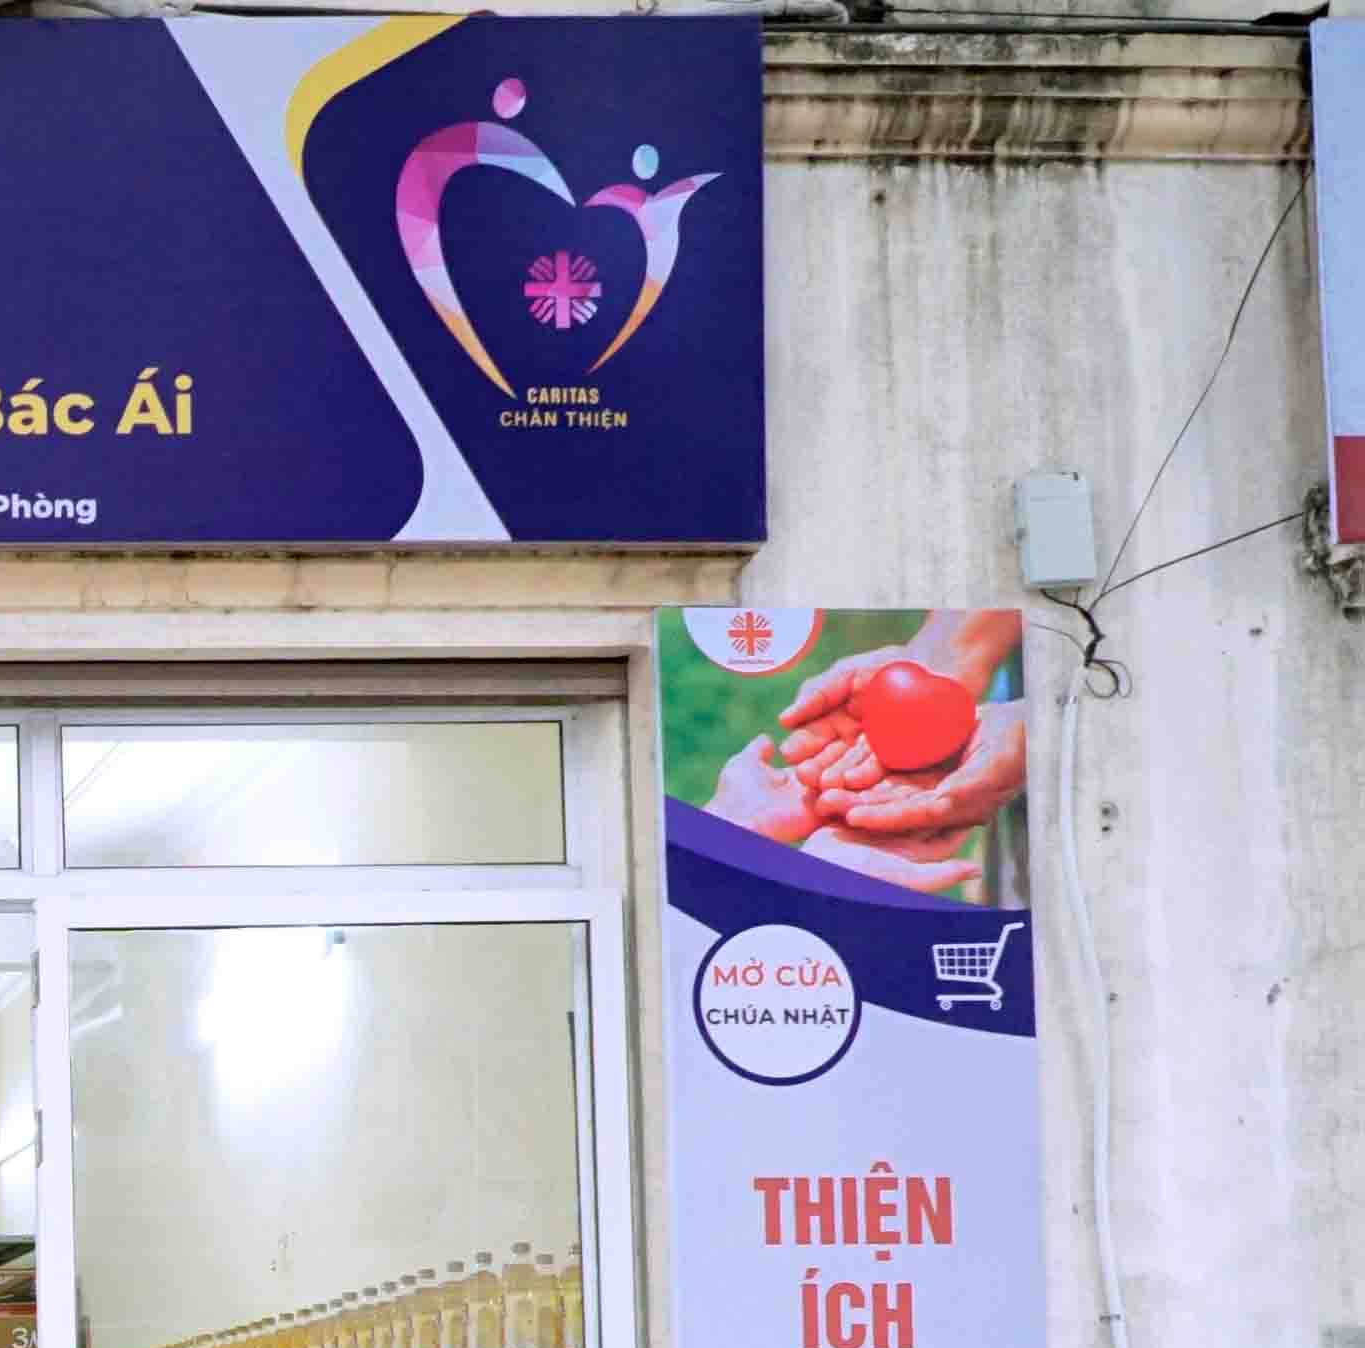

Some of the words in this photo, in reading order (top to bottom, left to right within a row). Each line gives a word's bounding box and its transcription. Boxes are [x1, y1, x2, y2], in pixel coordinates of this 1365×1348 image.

[116, 368, 192, 434] Ái
[527, 387, 599, 404] CARITAS
[500, 408, 557, 427] CHÂN
[566, 408, 627, 430] THIỆN
[714, 958, 763, 986] MỞ
[777, 958, 841, 986] CỬA
[706, 1005, 775, 1024] CHÚA
[784, 1005, 849, 1029] NHẬT
[754, 1162, 952, 1261] THIỆN
